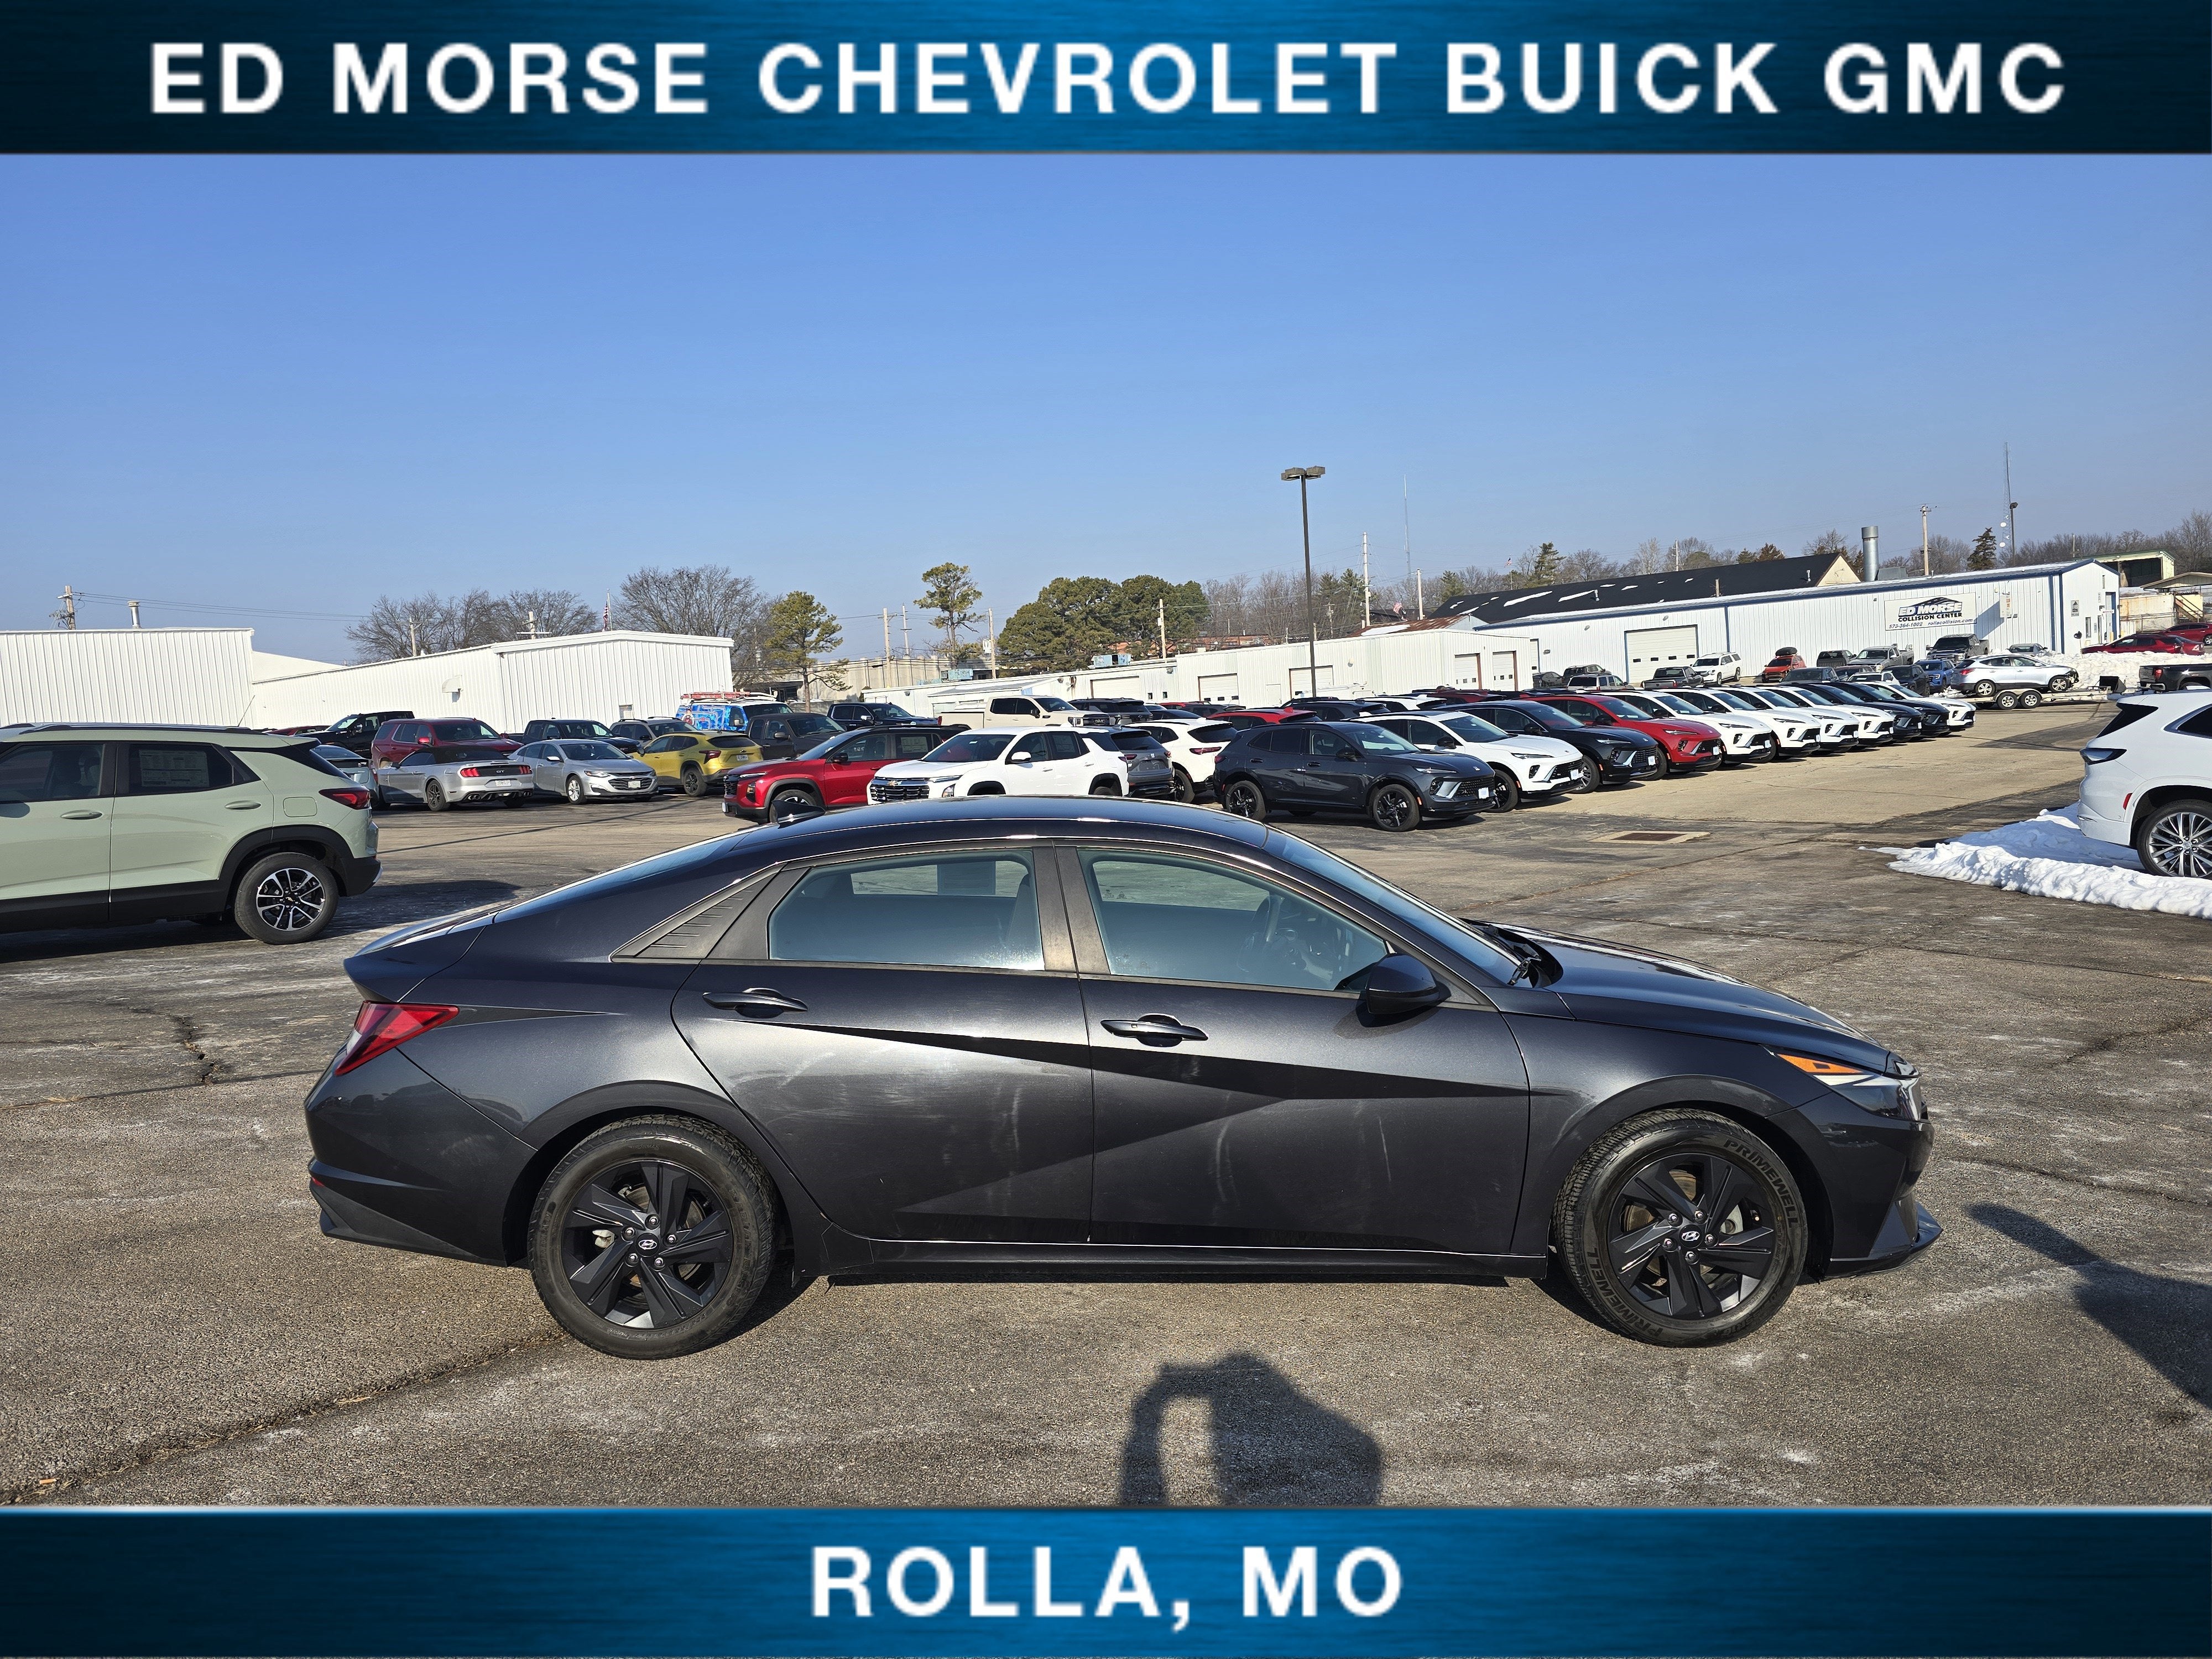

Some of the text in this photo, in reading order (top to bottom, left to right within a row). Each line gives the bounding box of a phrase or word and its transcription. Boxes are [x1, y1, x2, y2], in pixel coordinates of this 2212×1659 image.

[1898, 602, 1963, 617] ED MORSE
[1723, 1138, 1799, 1229] PRIMEWELL
[1587, 1247, 1664, 1337] PRIMEWELL
